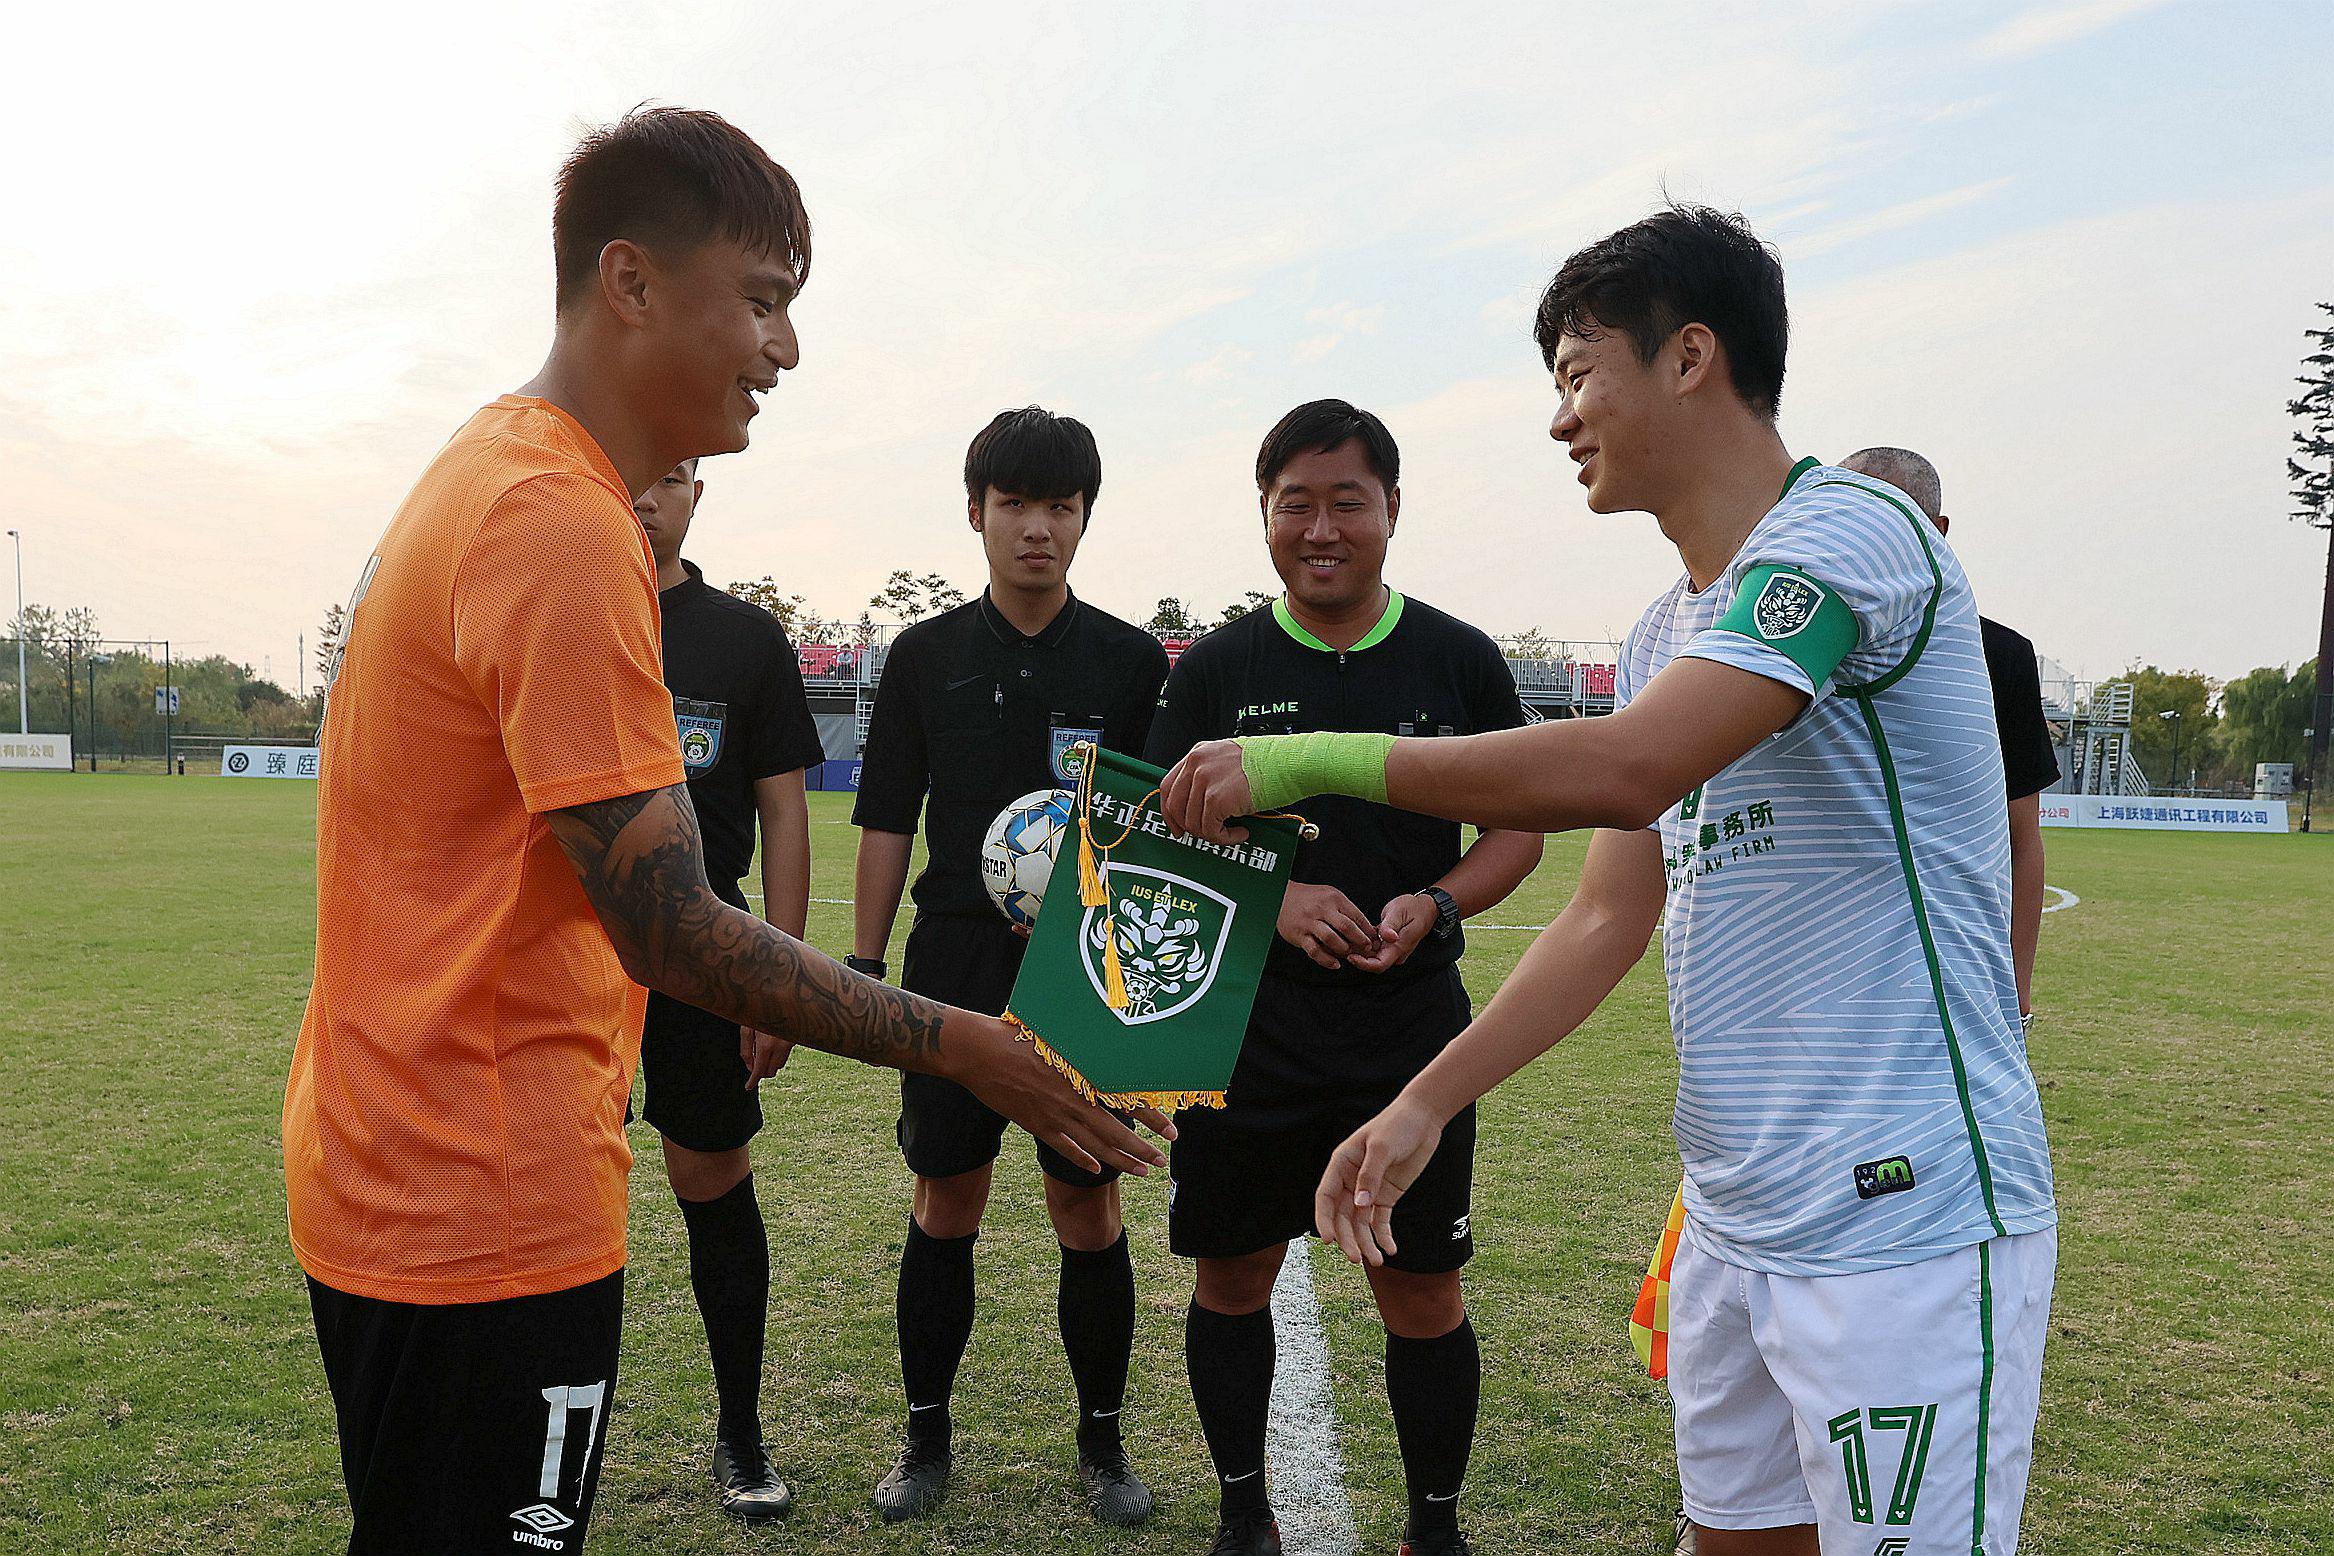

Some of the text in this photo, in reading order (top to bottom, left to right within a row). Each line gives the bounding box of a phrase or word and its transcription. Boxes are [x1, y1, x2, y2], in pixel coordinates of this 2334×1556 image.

[1237, 701, 1299, 719] KELME
[679, 718, 720, 731] REFEREE
[0, 744, 54, 758] 有限公司
[265, 752, 318, 776] 臻庭
[1695, 835, 1776, 877] LAW FIRM
[1131, 884, 1198, 914] IUS ET LEX
[539, 1379, 607, 1509] 17
[1826, 1402, 1939, 1526] 17
[512, 1530, 565, 1552] umbro
